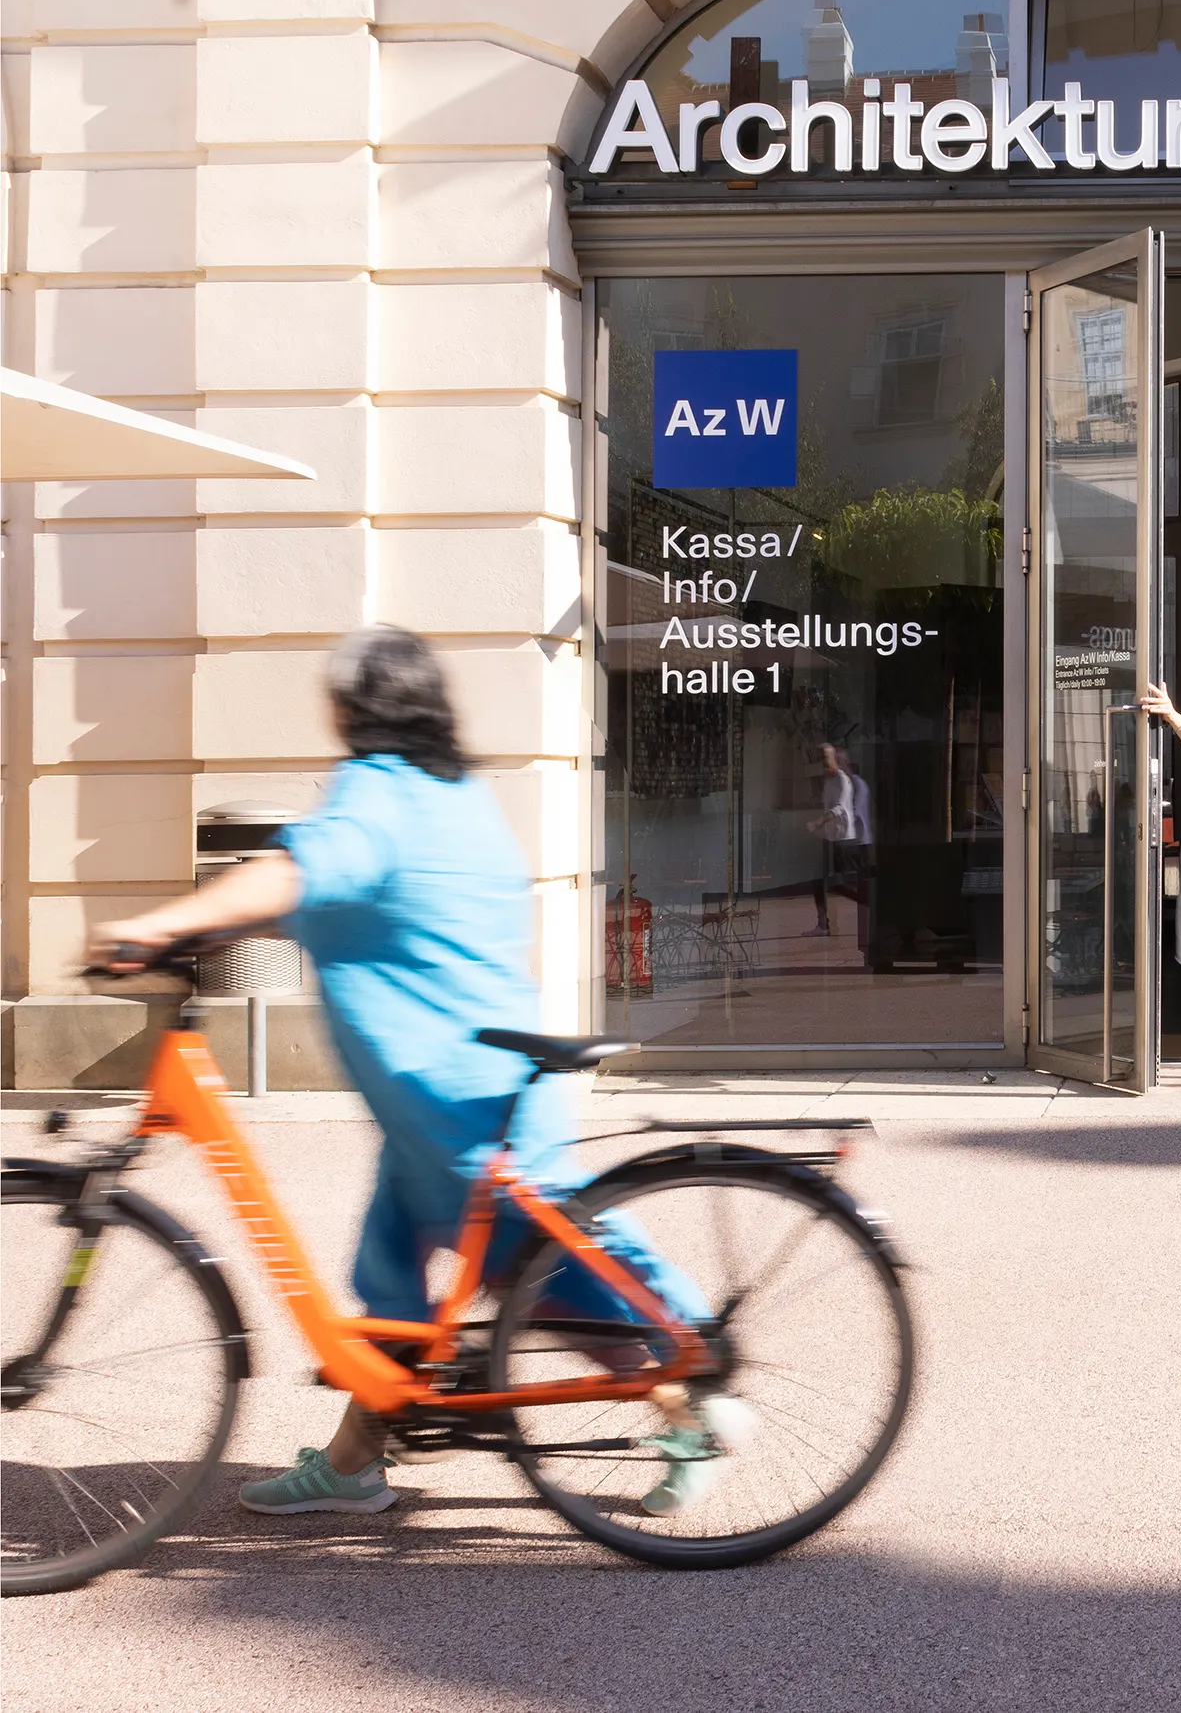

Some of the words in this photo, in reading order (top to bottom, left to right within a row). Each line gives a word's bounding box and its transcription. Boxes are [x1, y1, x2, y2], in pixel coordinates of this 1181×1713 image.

[662, 524, 803, 559] Kassa/
[662, 571, 757, 604] Info/
[659, 614, 939, 657] Ausstellungs-
[661, 660, 755, 694] halle
[766, 661, 780, 693] 1
[1055, 654, 1079, 669] Eingang
[1055, 669, 1073, 679] Entrance
